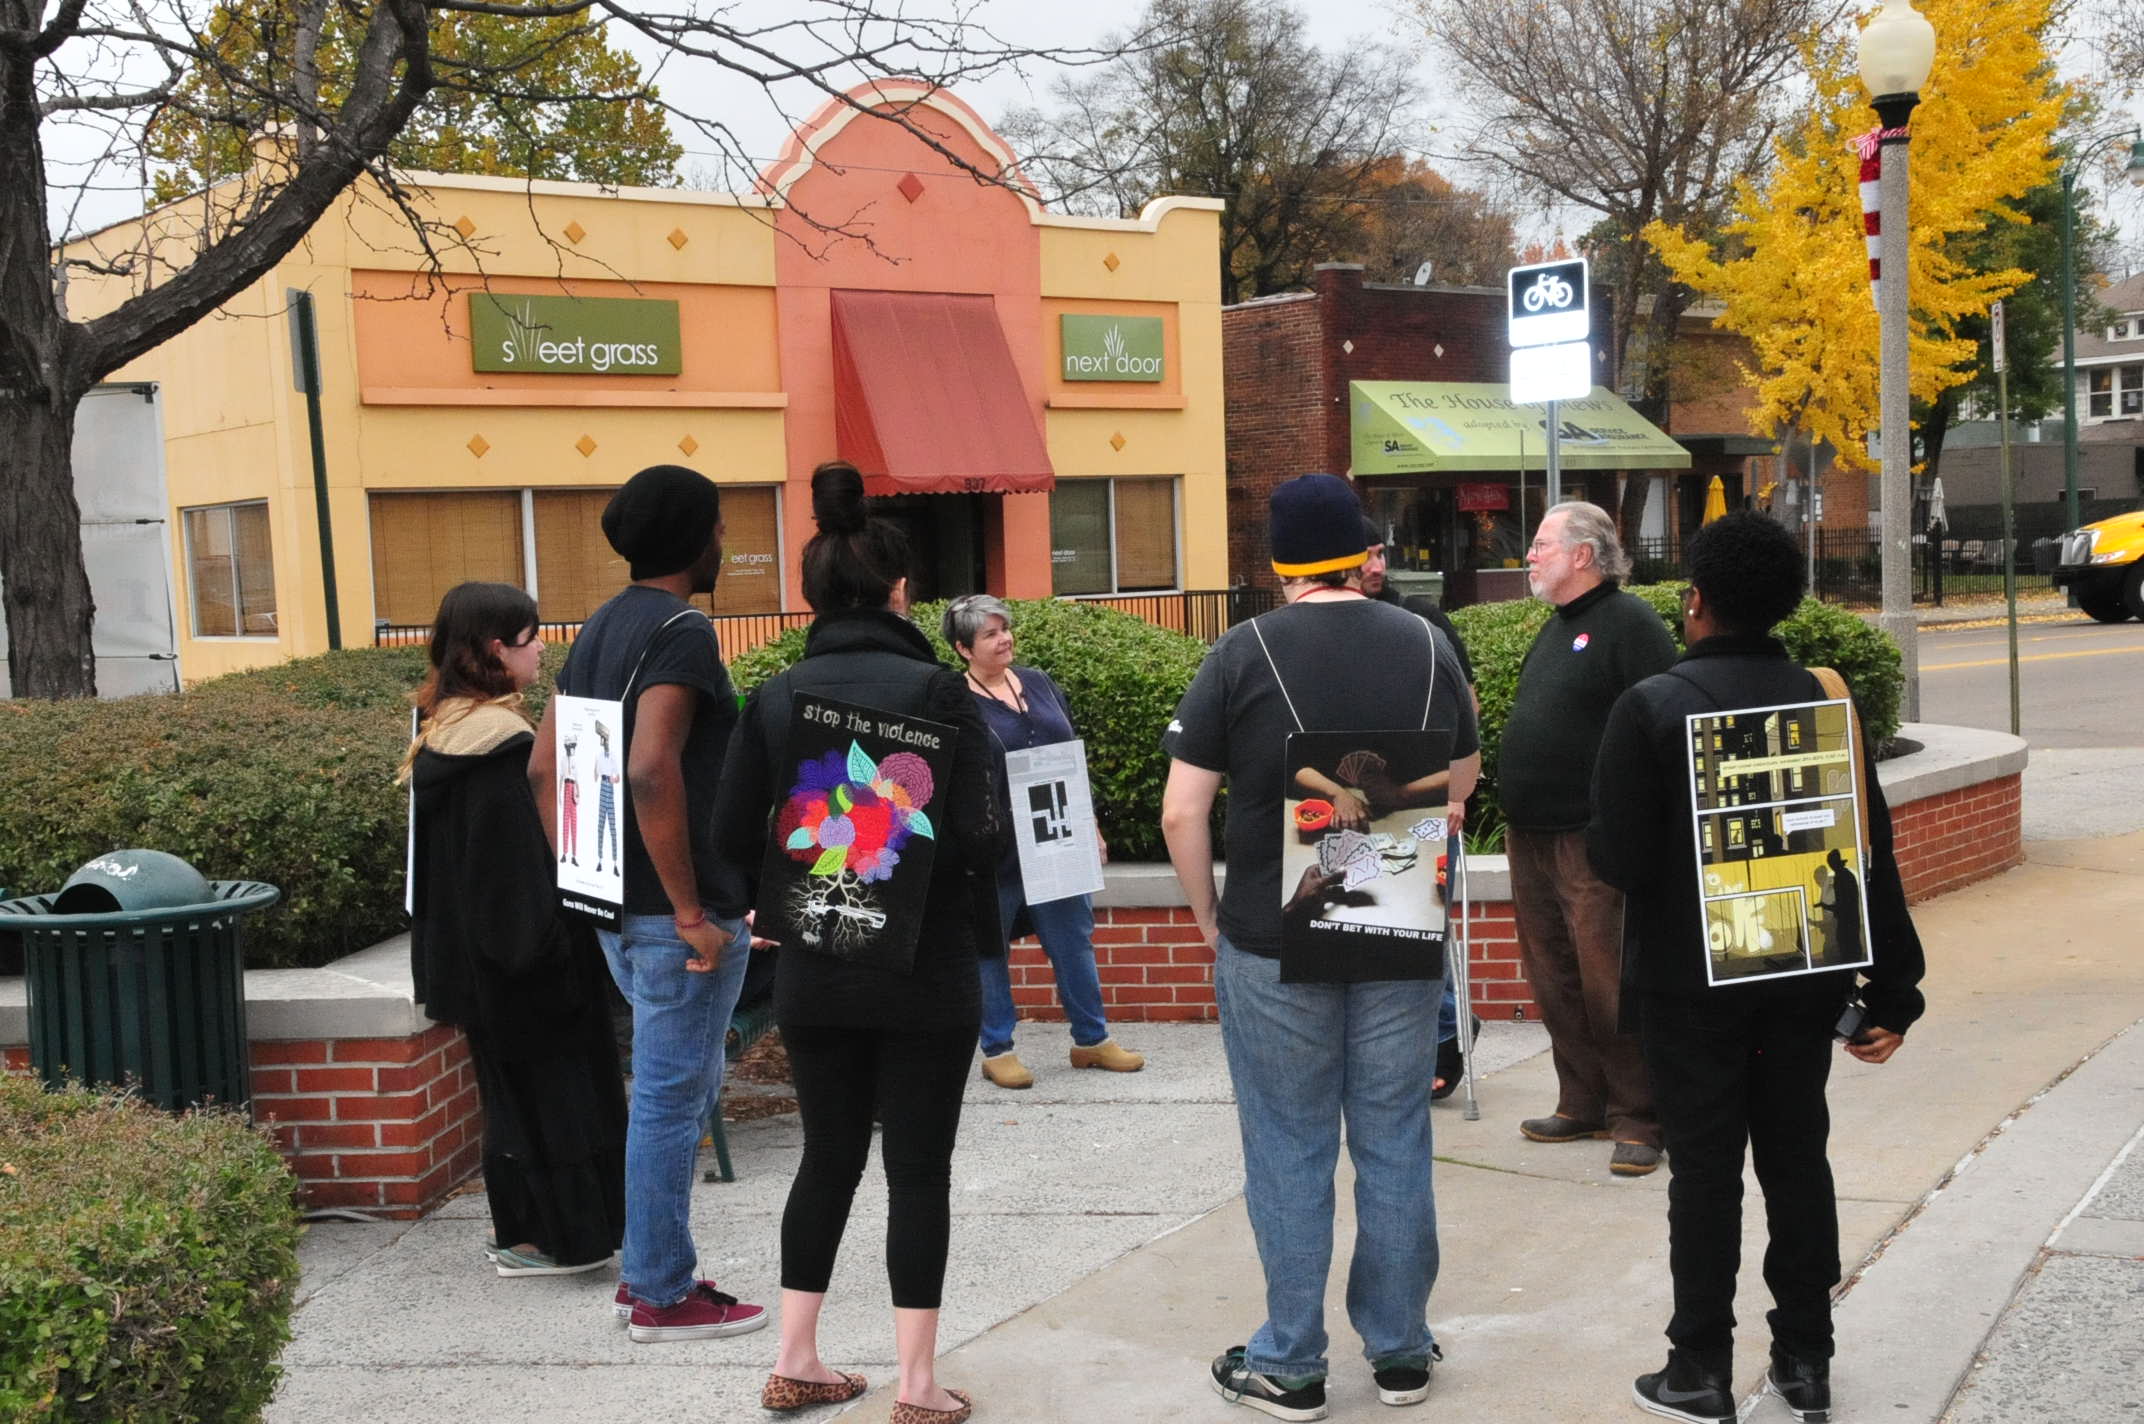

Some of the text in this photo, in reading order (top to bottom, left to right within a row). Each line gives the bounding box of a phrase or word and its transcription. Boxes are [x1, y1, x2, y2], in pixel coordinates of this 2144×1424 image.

[590, 342, 658, 371] grass
[1066, 351, 1162, 374] next door
[1389, 391, 1439, 409] The
[1441, 392, 1518, 410] House
[1384, 439, 1400, 453] SA
[749, 552, 773, 566] grass
[803, 703, 841, 728] stop
[846, 711, 872, 734] the
[1309, 919, 1444, 942] DON'T BET WITH YOUR LIFE
